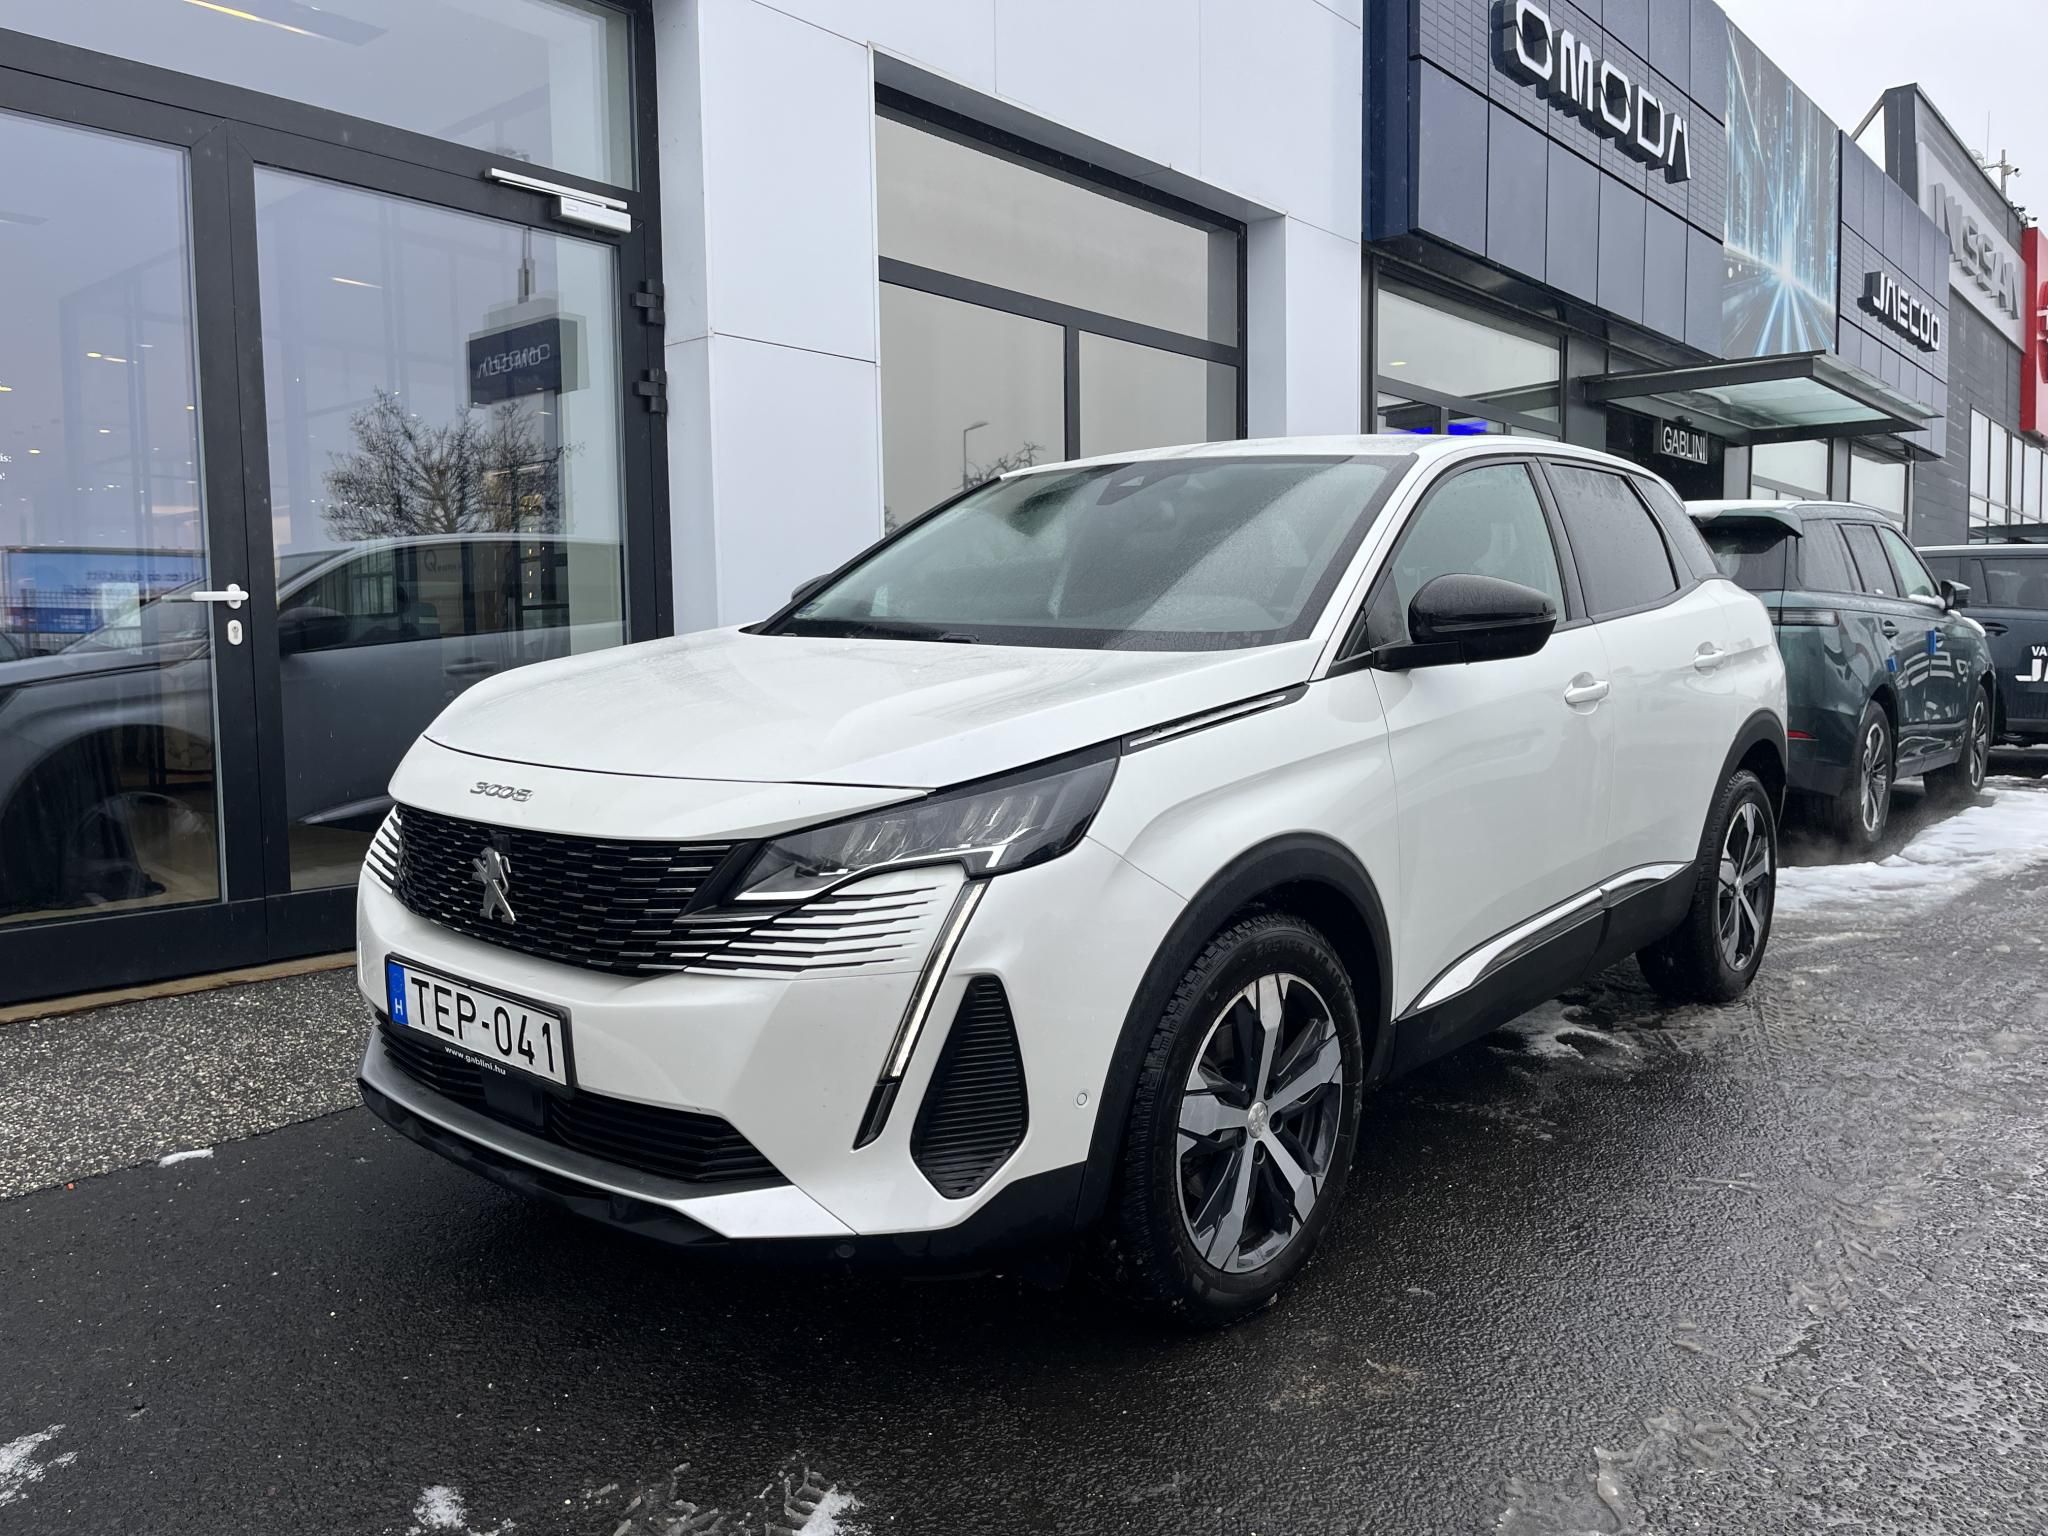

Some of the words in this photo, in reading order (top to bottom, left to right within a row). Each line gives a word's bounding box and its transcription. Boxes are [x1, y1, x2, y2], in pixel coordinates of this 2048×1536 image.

[1516, 0, 1691, 180] OMODA
[1873, 271, 1940, 351] JAECOO
[1663, 426, 1706, 461] GABLINI
[470, 781, 534, 802] 3008
[394, 997, 405, 1017] H
[411, 976, 555, 1073] TEP-041
[444, 1046, 507, 1076] www.gablini.hu
